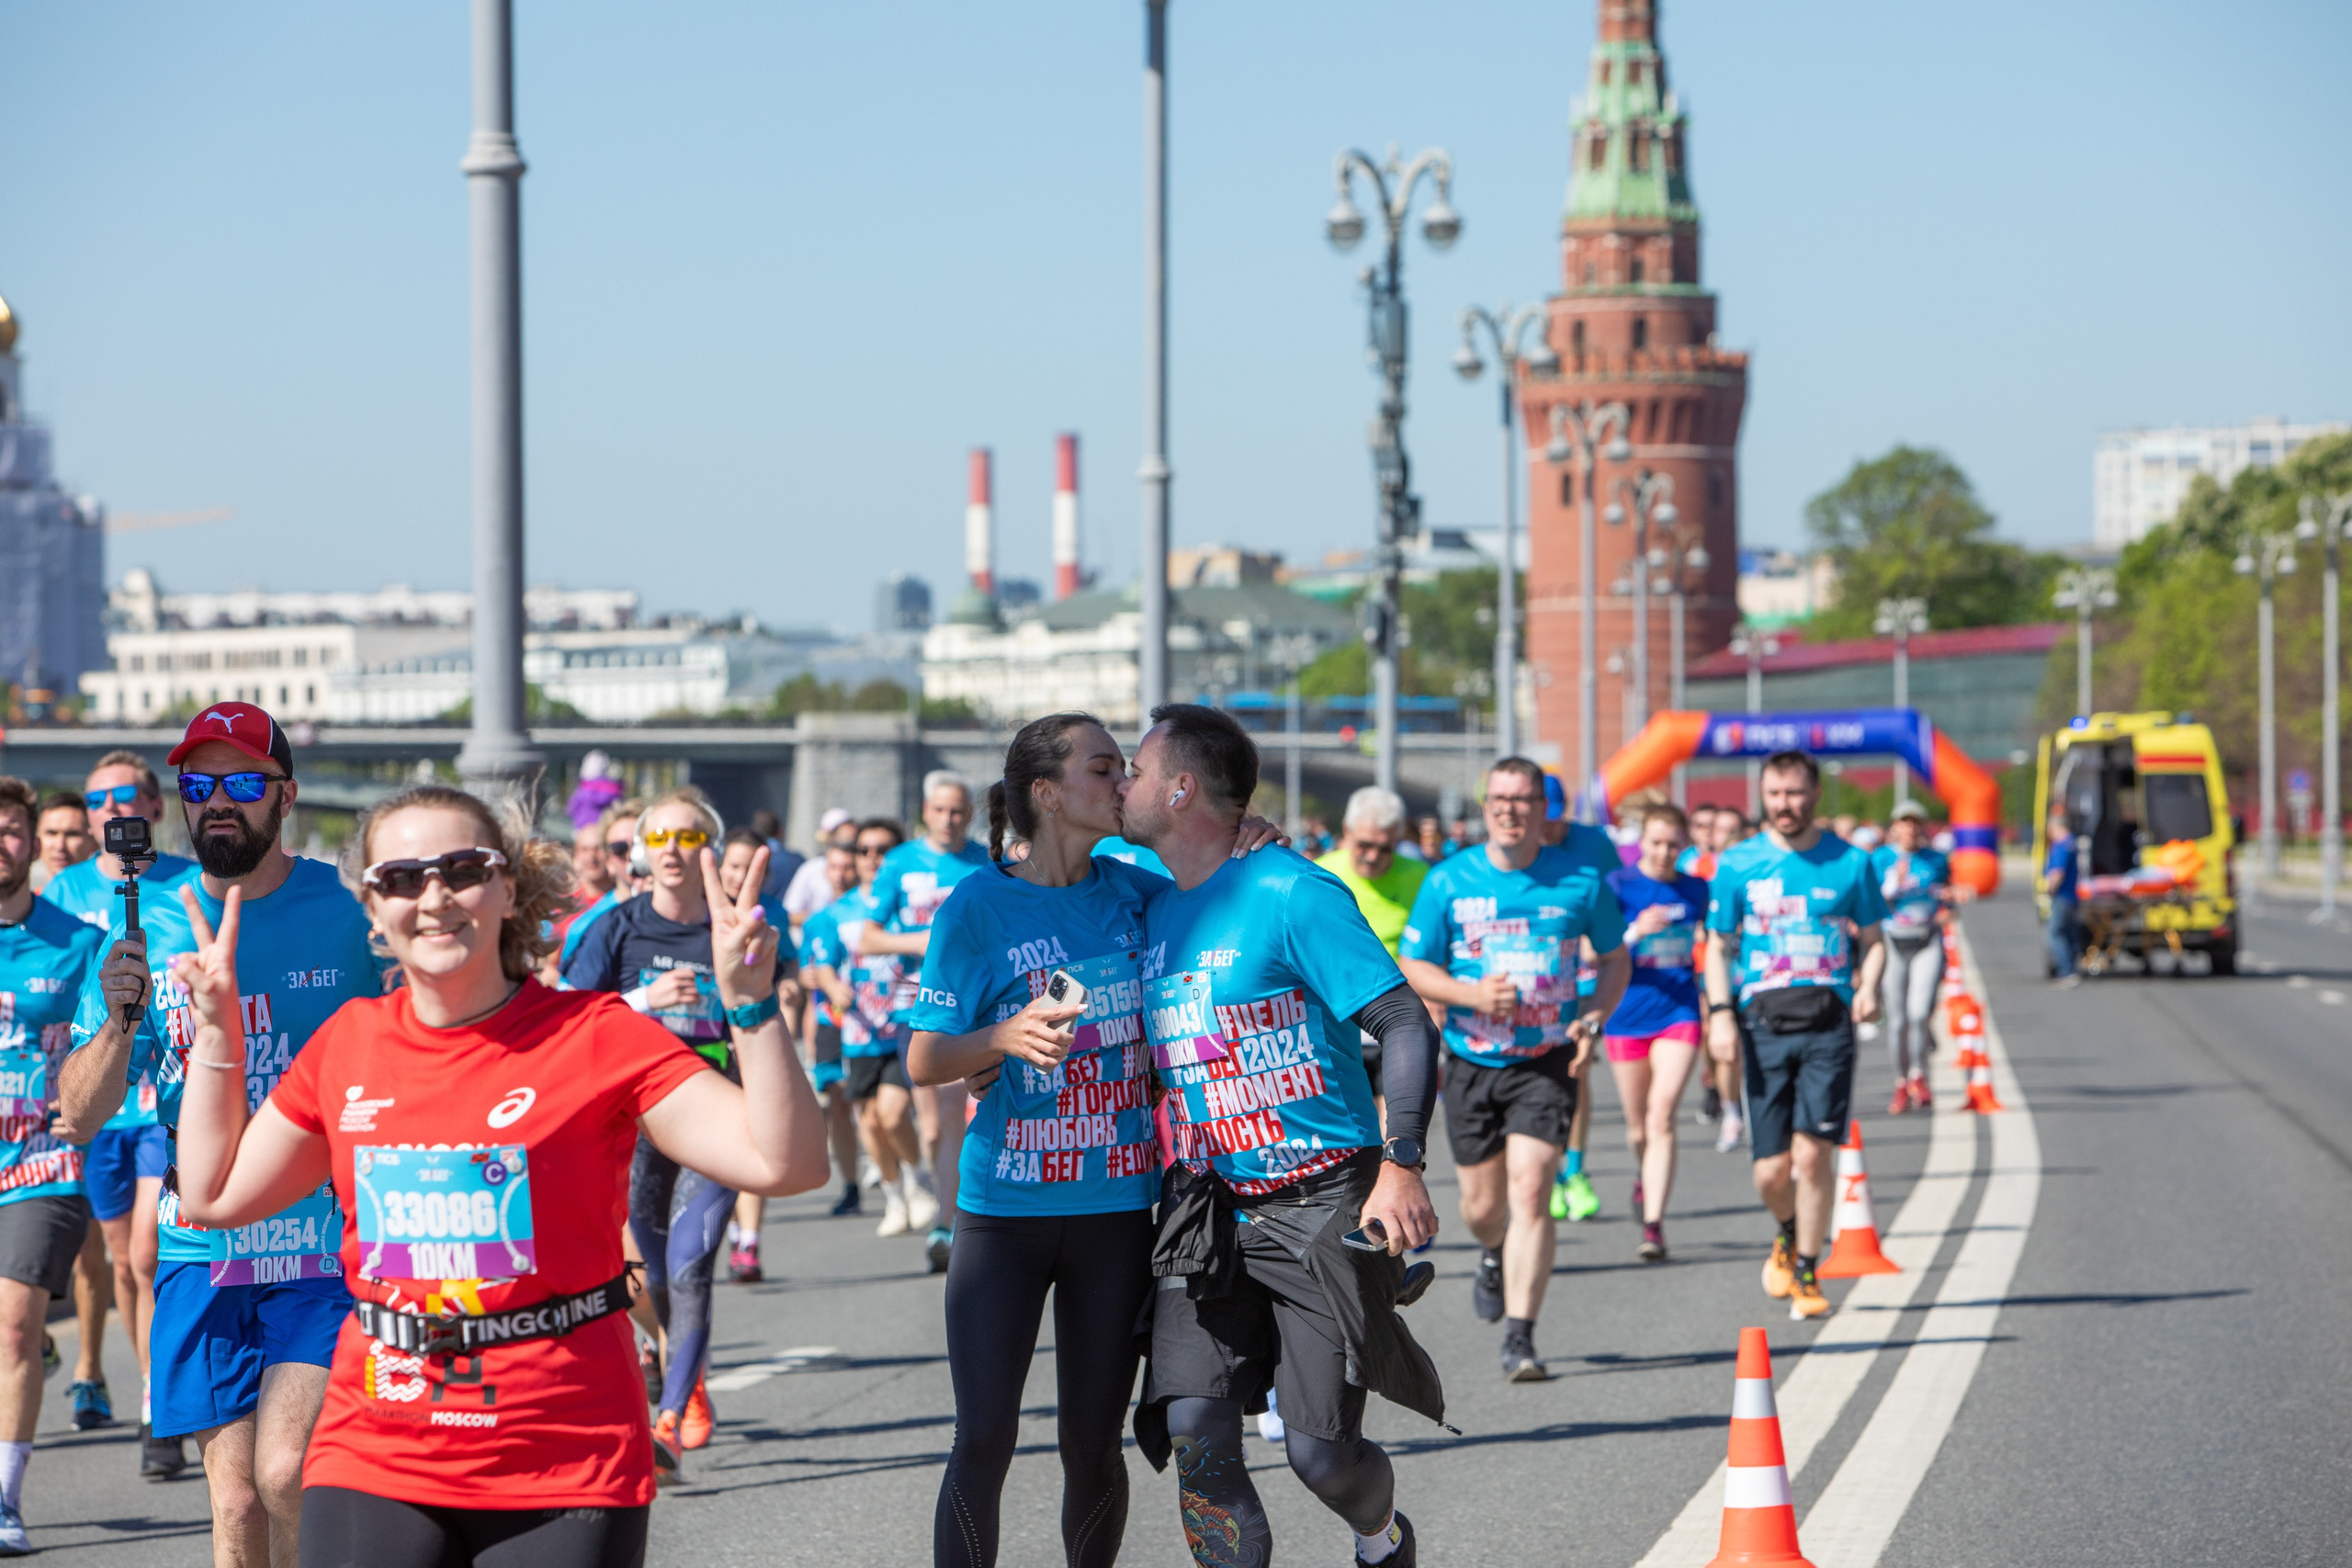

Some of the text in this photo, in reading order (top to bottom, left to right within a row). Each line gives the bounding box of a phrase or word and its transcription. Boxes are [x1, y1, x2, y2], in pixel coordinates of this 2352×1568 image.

[1008, 936, 1069, 977] 2024
[920, 987, 957, 1008] ПСБ
[1215, 988, 1307, 1041] #ЦЕЛЬ
[1152, 1001, 1202, 1040] 30043
[1243, 1023, 1315, 1074] 2024
[1203, 1059, 1328, 1120] #МОМЕНТ
[1005, 1113, 1118, 1151] #ЛЮБОВЬ
[485, 1168, 503, 1183] C
[996, 1148, 1084, 1183] #ЗАБЕГ
[1258, 1134, 1323, 1179] 2024
[383, 1190, 498, 1238] 33086
[233, 1217, 319, 1254] 30254
[323, 1258, 334, 1270] D
[431, 1411, 498, 1427] MOSCOW
